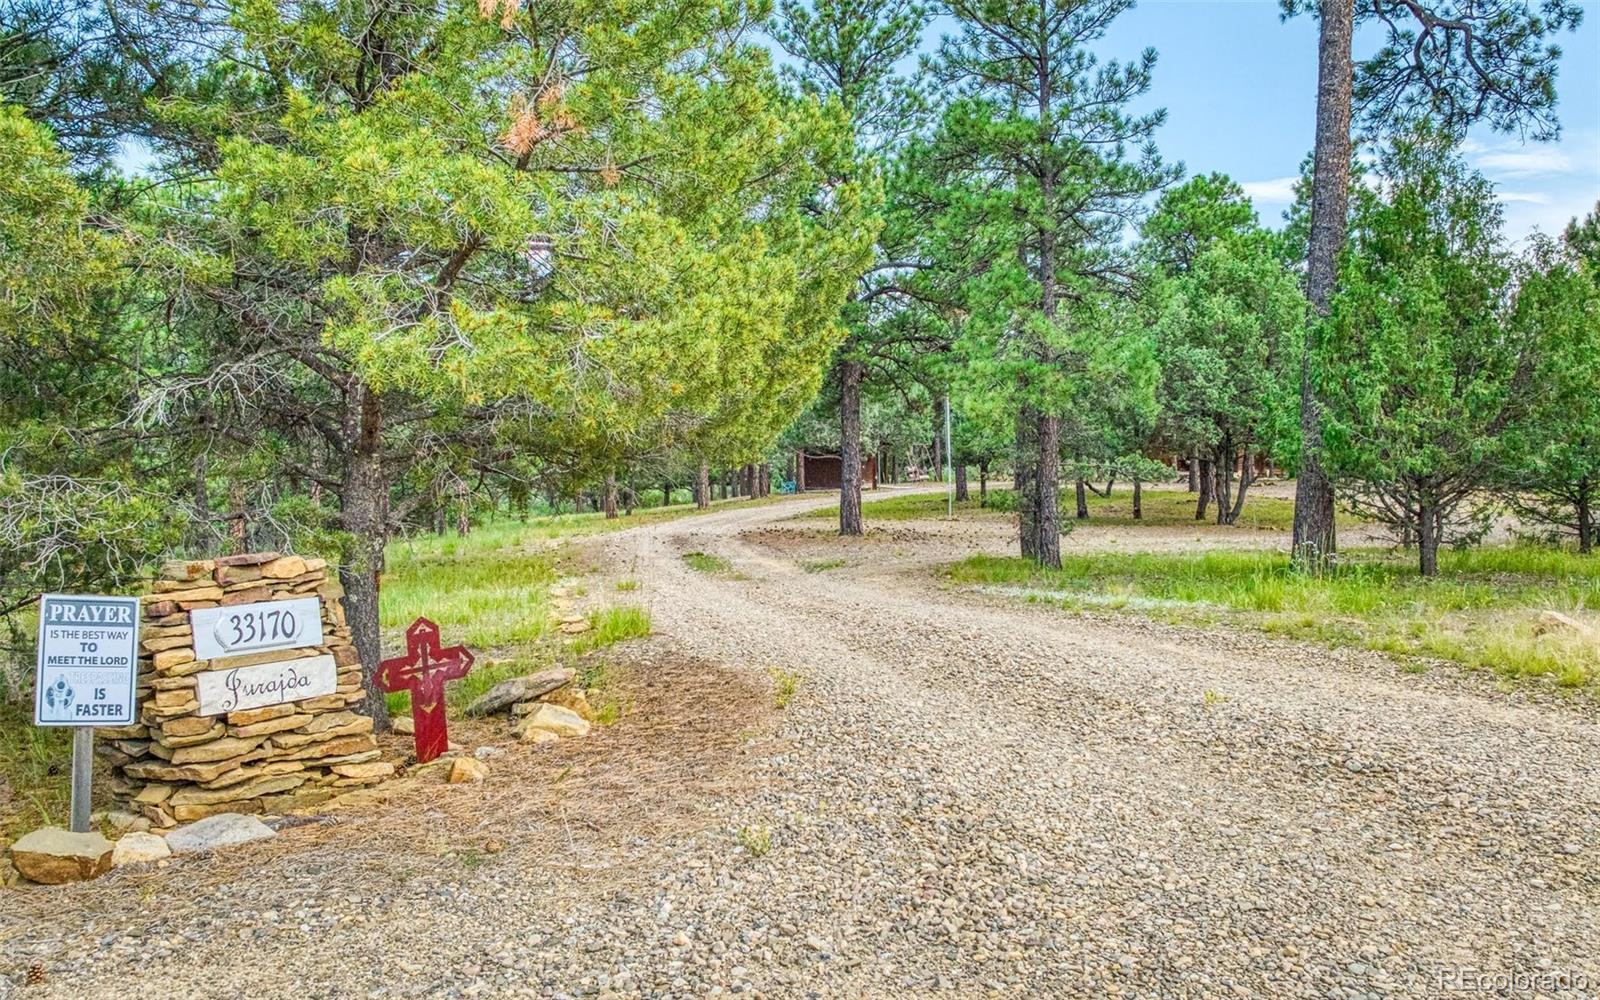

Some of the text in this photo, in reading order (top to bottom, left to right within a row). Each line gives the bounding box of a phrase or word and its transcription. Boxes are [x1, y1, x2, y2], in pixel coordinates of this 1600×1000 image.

[50, 604, 132, 623] PRAYER
[230, 610, 295, 645] 33170
[50, 630, 129, 640] IS THE BEST WAY
[80, 642, 98, 652] TO
[47, 655, 128, 665] MEET THE LORD
[93, 687, 106, 700] IS
[75, 704, 123, 716] FASTER
